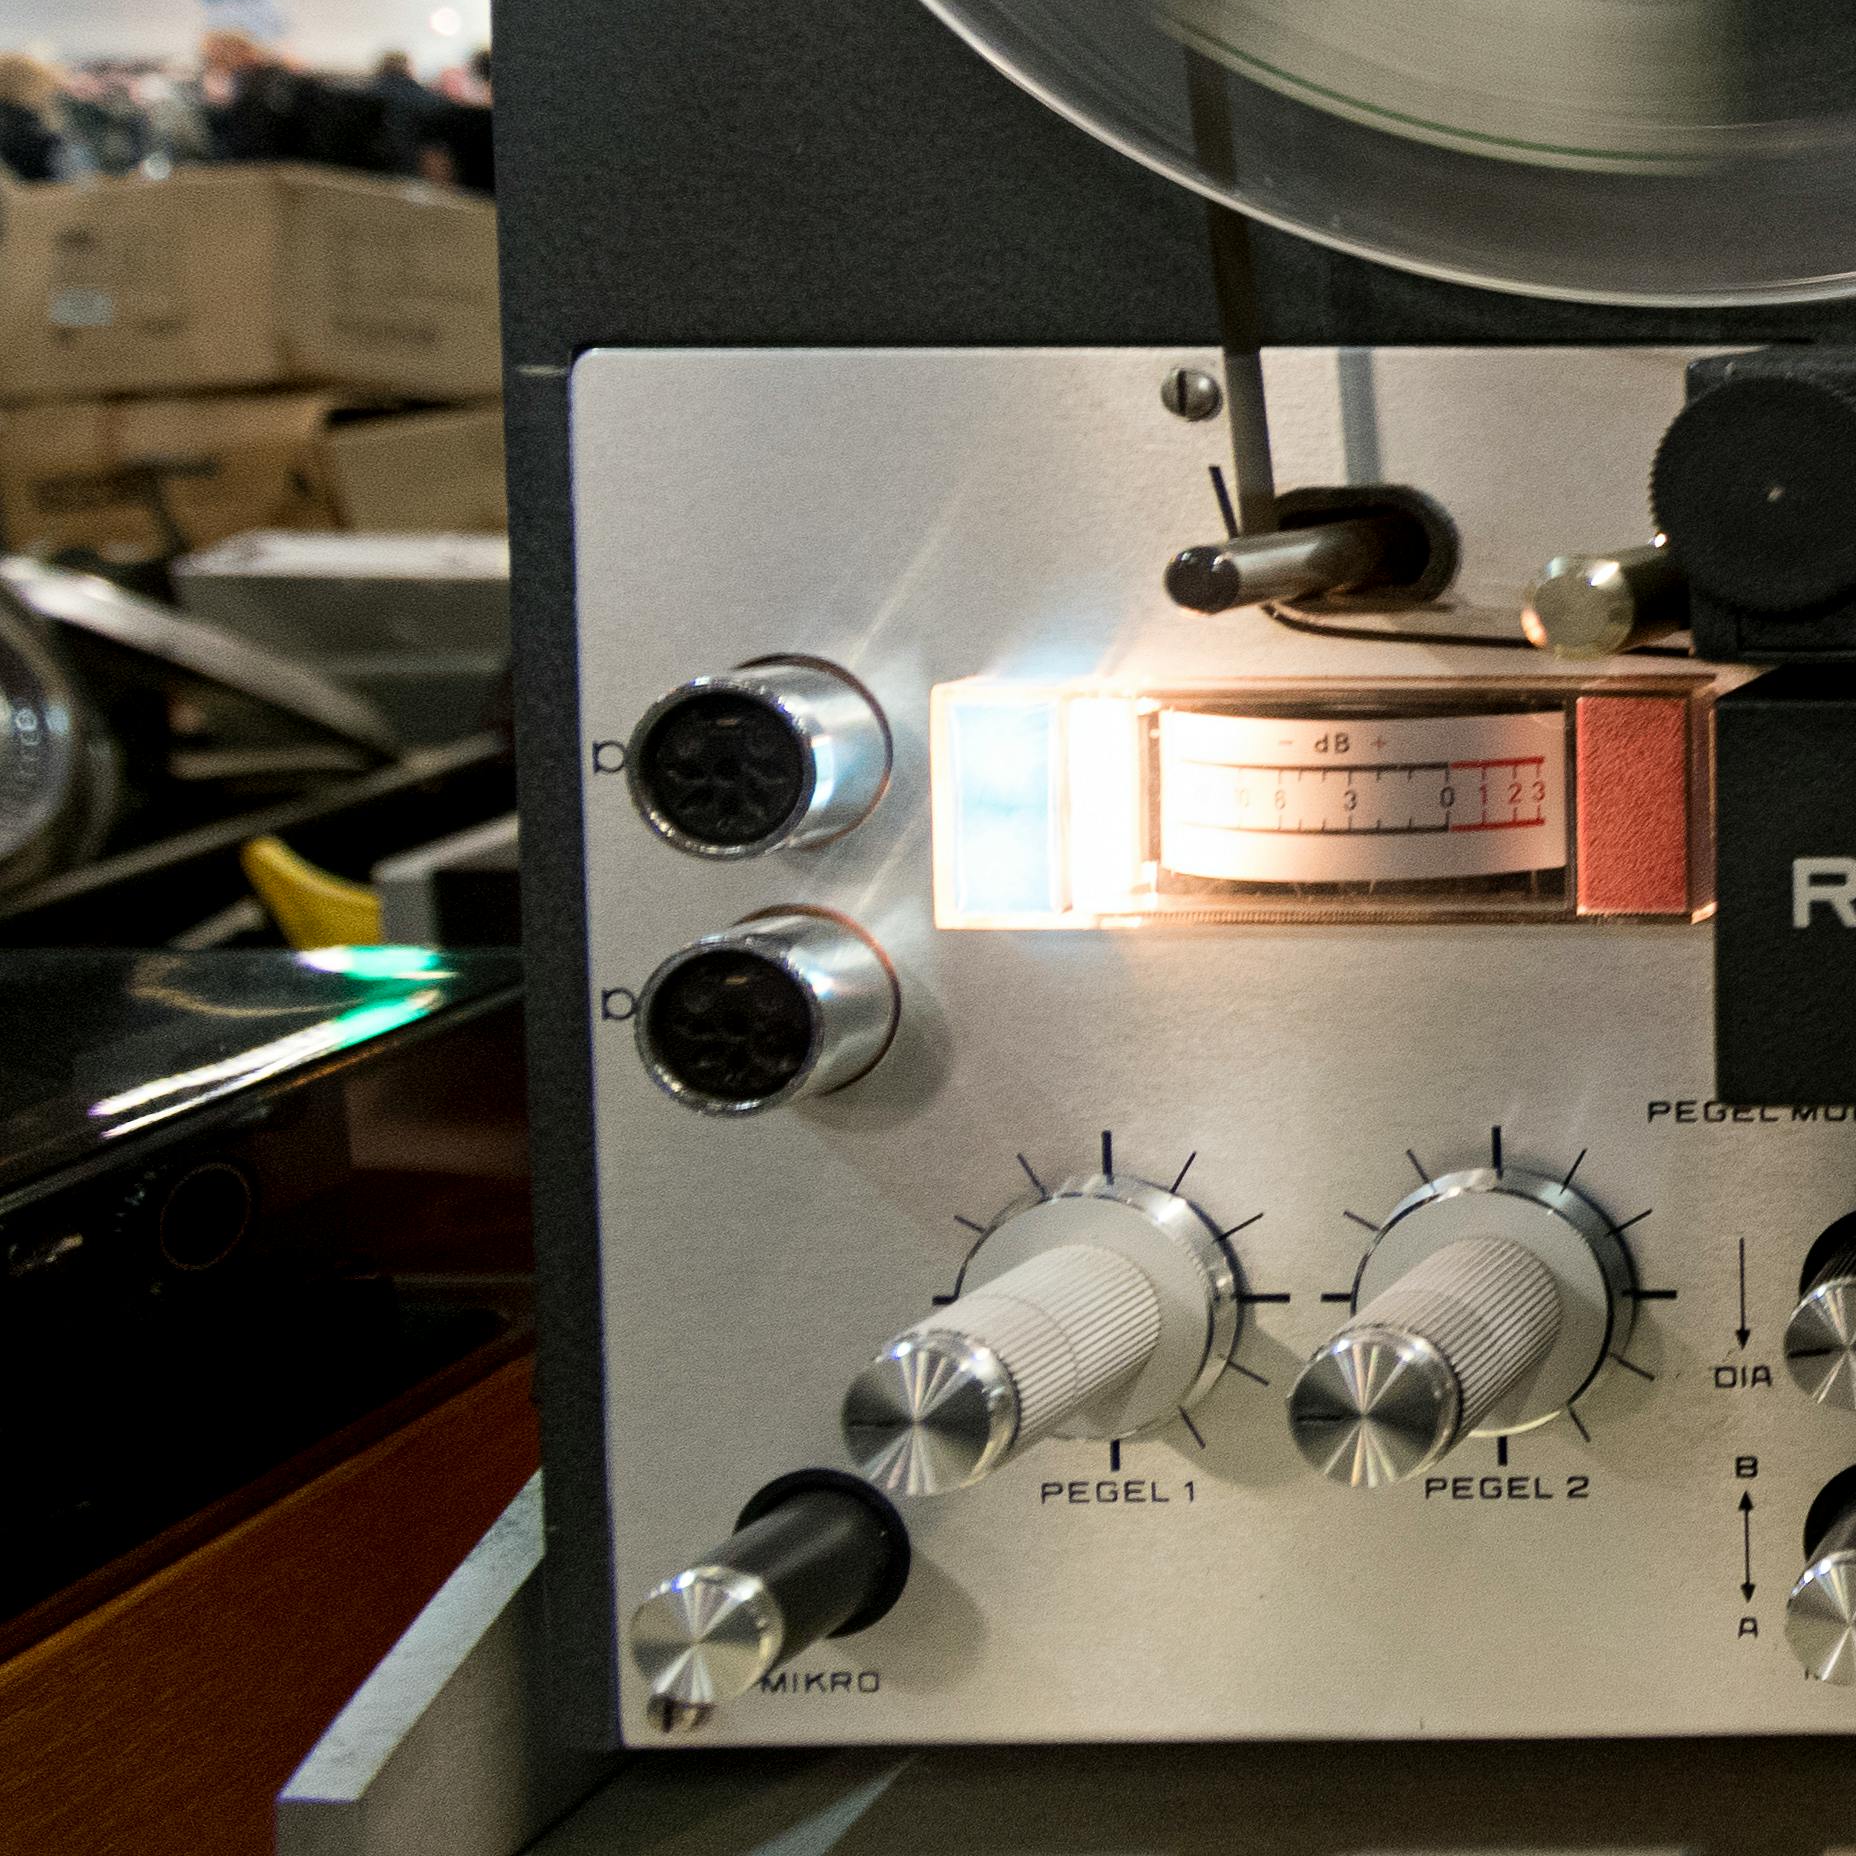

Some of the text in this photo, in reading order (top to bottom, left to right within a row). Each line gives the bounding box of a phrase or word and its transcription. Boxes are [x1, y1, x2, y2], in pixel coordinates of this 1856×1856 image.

[1315, 732, 1351, 754] dB
[1344, 789, 1358, 811] 3
[1440, 785, 1456, 808] 0
[1478, 785, 1489, 805] 1
[1509, 783, 1522, 804] 2
[1532, 781, 1546, 802] 3
[1648, 1100, 1778, 1123] PEGEL
[1713, 1364, 1773, 1389] DIA
[1735, 1455, 1759, 1479] B
[1041, 1480, 1195, 1505] PEGEL 1
[1425, 1475, 1590, 1500] PEGEL 2
[1738, 1617, 1759, 1639] A
[761, 1670, 880, 1694] MIKRO
